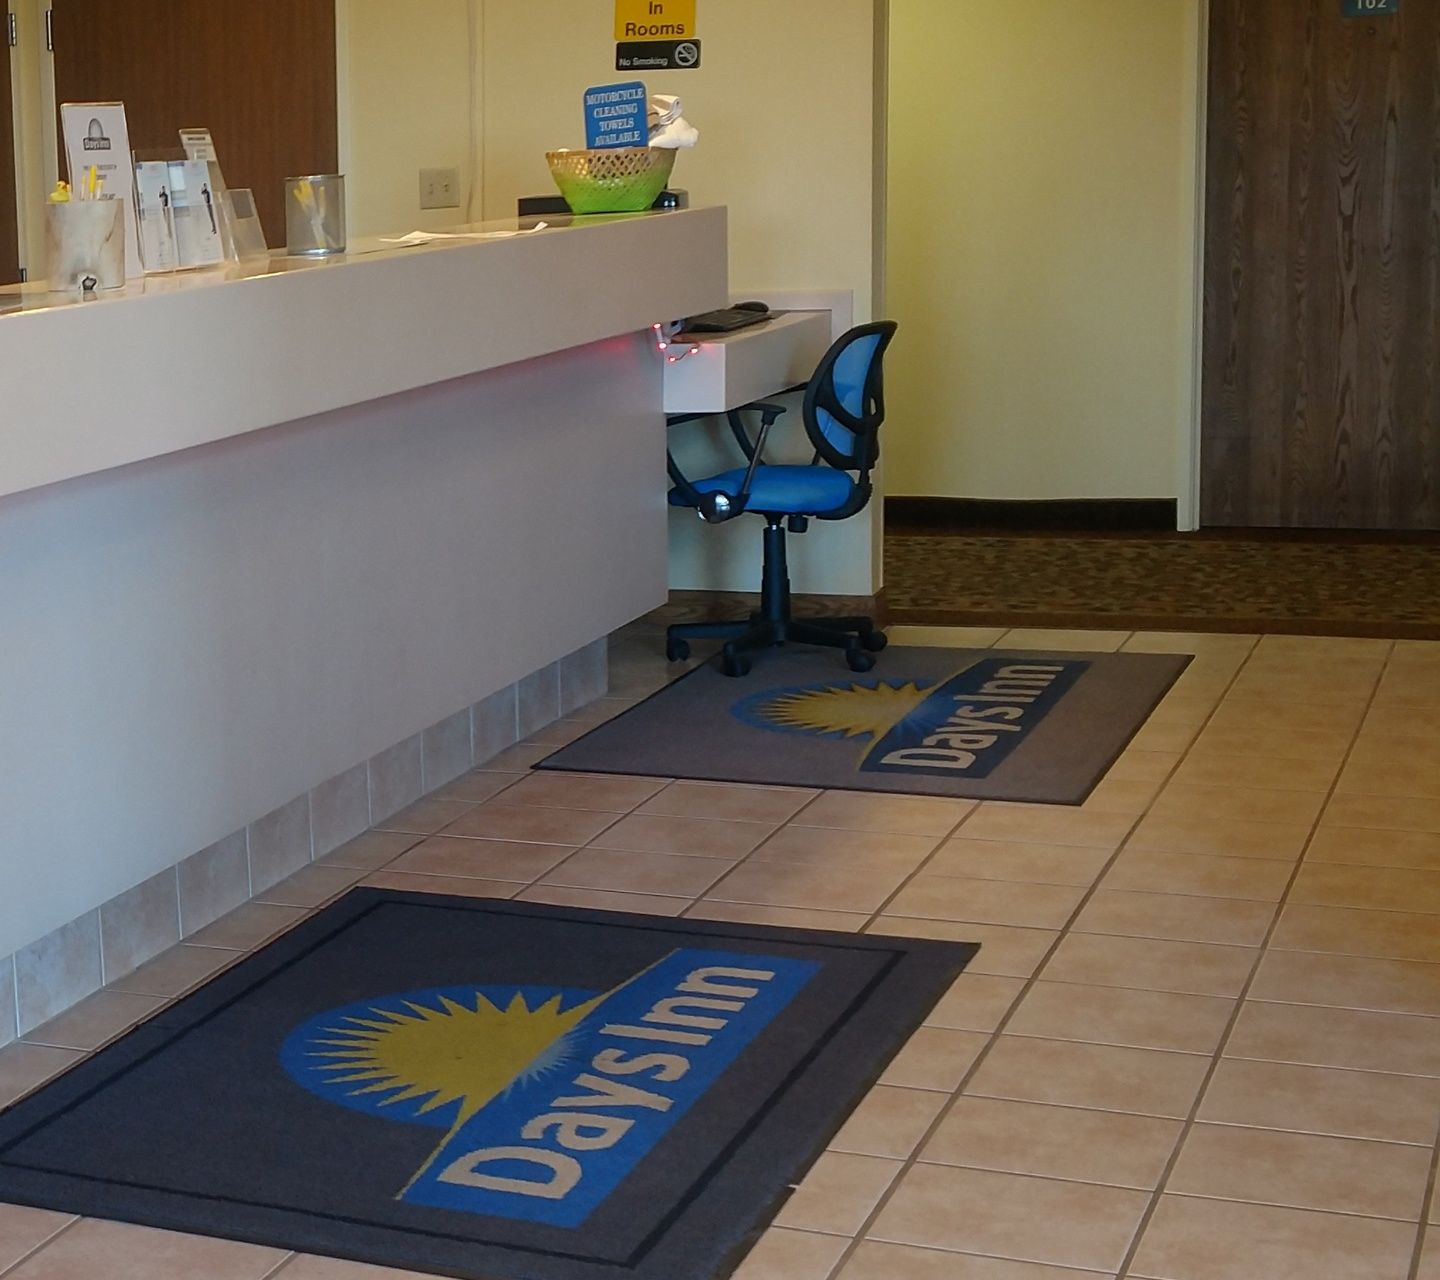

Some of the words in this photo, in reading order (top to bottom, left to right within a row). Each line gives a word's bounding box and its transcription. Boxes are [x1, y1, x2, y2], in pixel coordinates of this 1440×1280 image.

[648, 1, 663, 15] In
[625, 22, 685, 36] Rooms
[618, 57, 631, 67] No
[632, 56, 669, 66] Smoking
[586, 88, 644, 106] MOTORCYCLE
[594, 102, 638, 119] CLEANING
[599, 117, 635, 131] TOWELS
[594, 130, 641, 147] AVAILABLE
